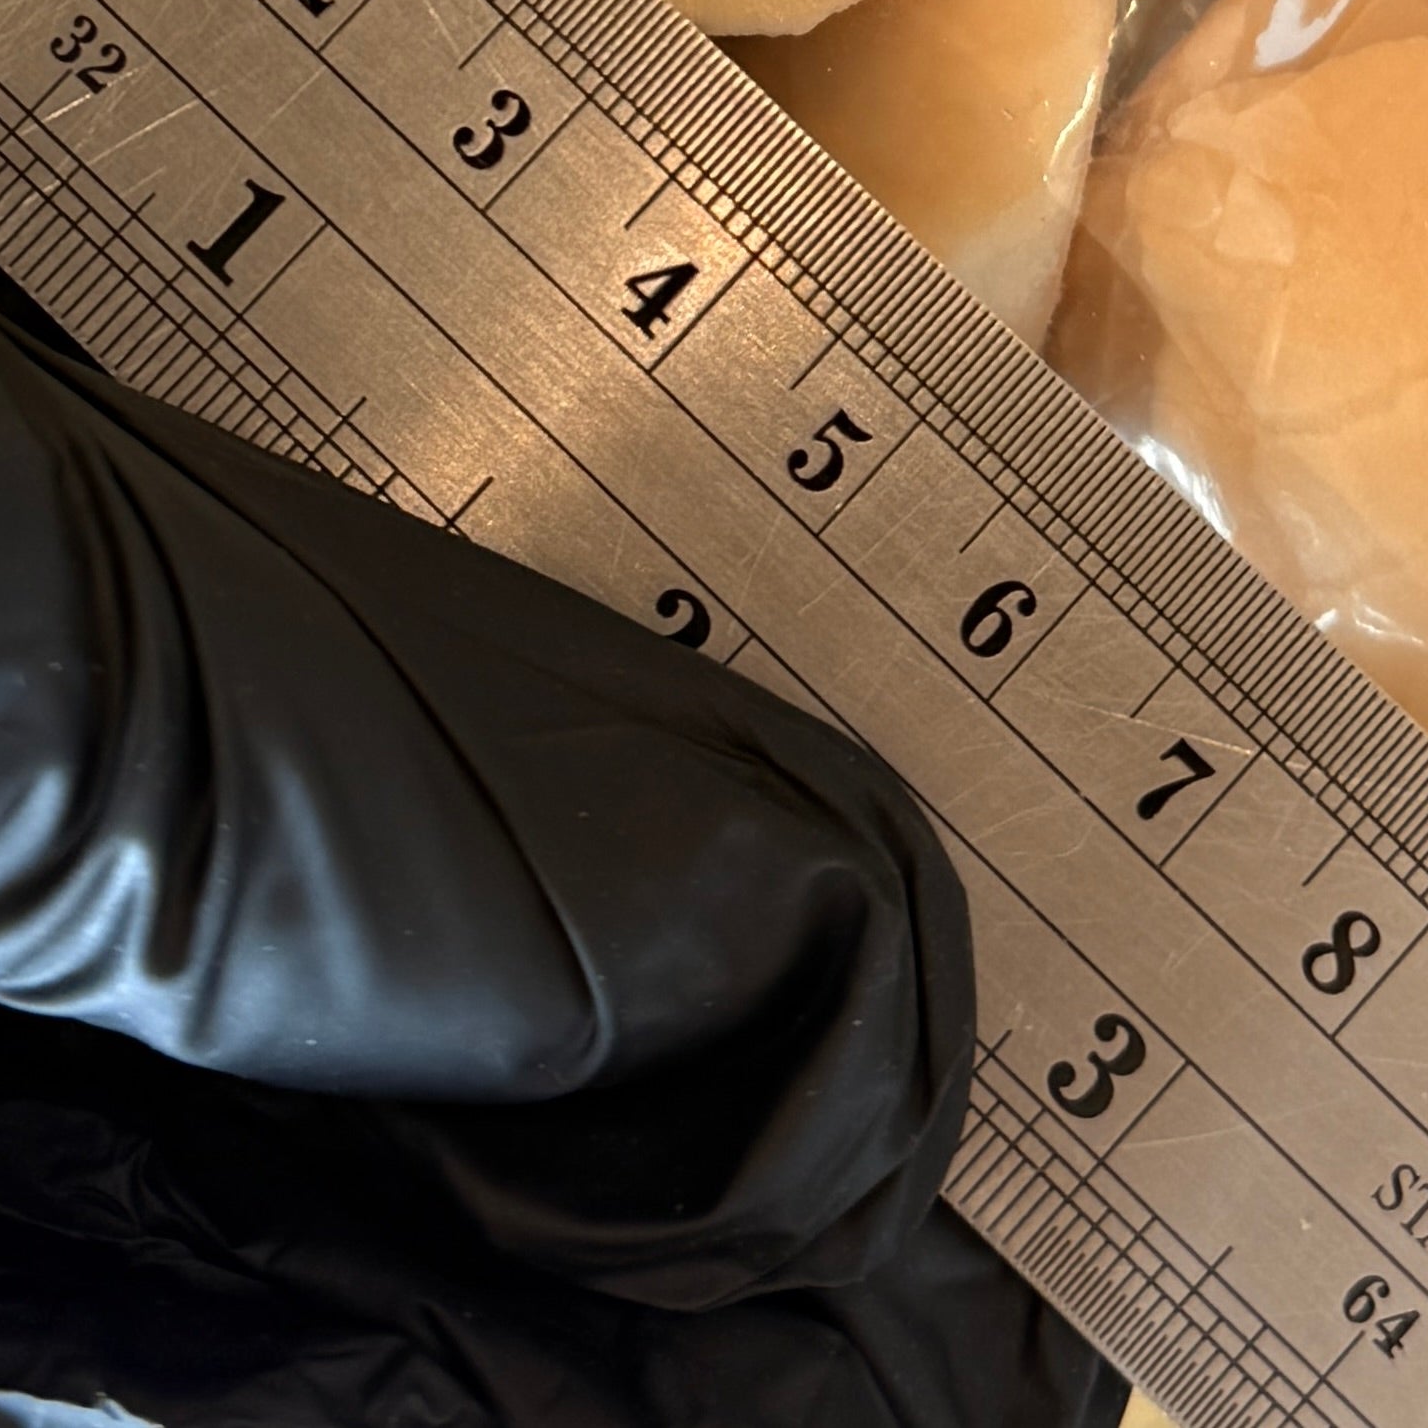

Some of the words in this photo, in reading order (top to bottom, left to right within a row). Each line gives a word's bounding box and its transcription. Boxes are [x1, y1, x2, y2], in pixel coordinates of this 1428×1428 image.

[49, 14, 128, 94] 32
[452, 88, 532, 170] 3
[186, 177, 287, 288] 1
[620, 262, 700, 340] 4
[787, 408, 874, 493] 5
[959, 579, 1038, 658] 6
[1135, 736, 1217, 821] 7
[1301, 910, 1382, 996] 8
[1046, 1012, 1147, 1120] 3
[1342, 1274, 1422, 1360] 64
